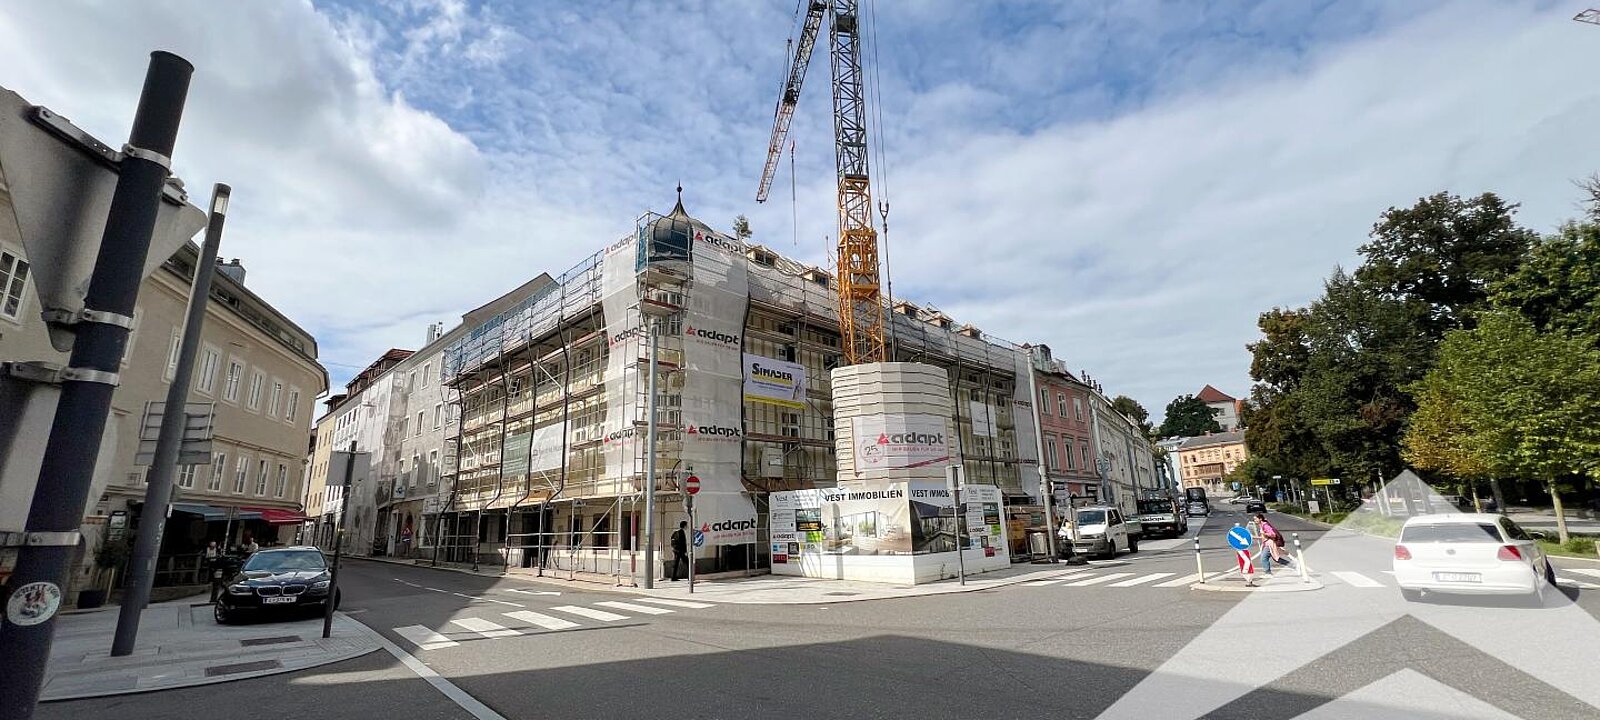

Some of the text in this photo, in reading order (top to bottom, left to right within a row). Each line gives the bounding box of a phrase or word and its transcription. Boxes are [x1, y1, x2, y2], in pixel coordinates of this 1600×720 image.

[705, 235, 744, 254] adapt
[697, 328, 739, 344] adapt
[699, 425, 741, 437] adapt
[891, 432, 944, 446] adapt
[825, 493, 846, 502] VEST
[848, 490, 903, 501] IMMOBILIEN
[911, 489, 928, 498] VEST
[712, 518, 756, 531] adapt
